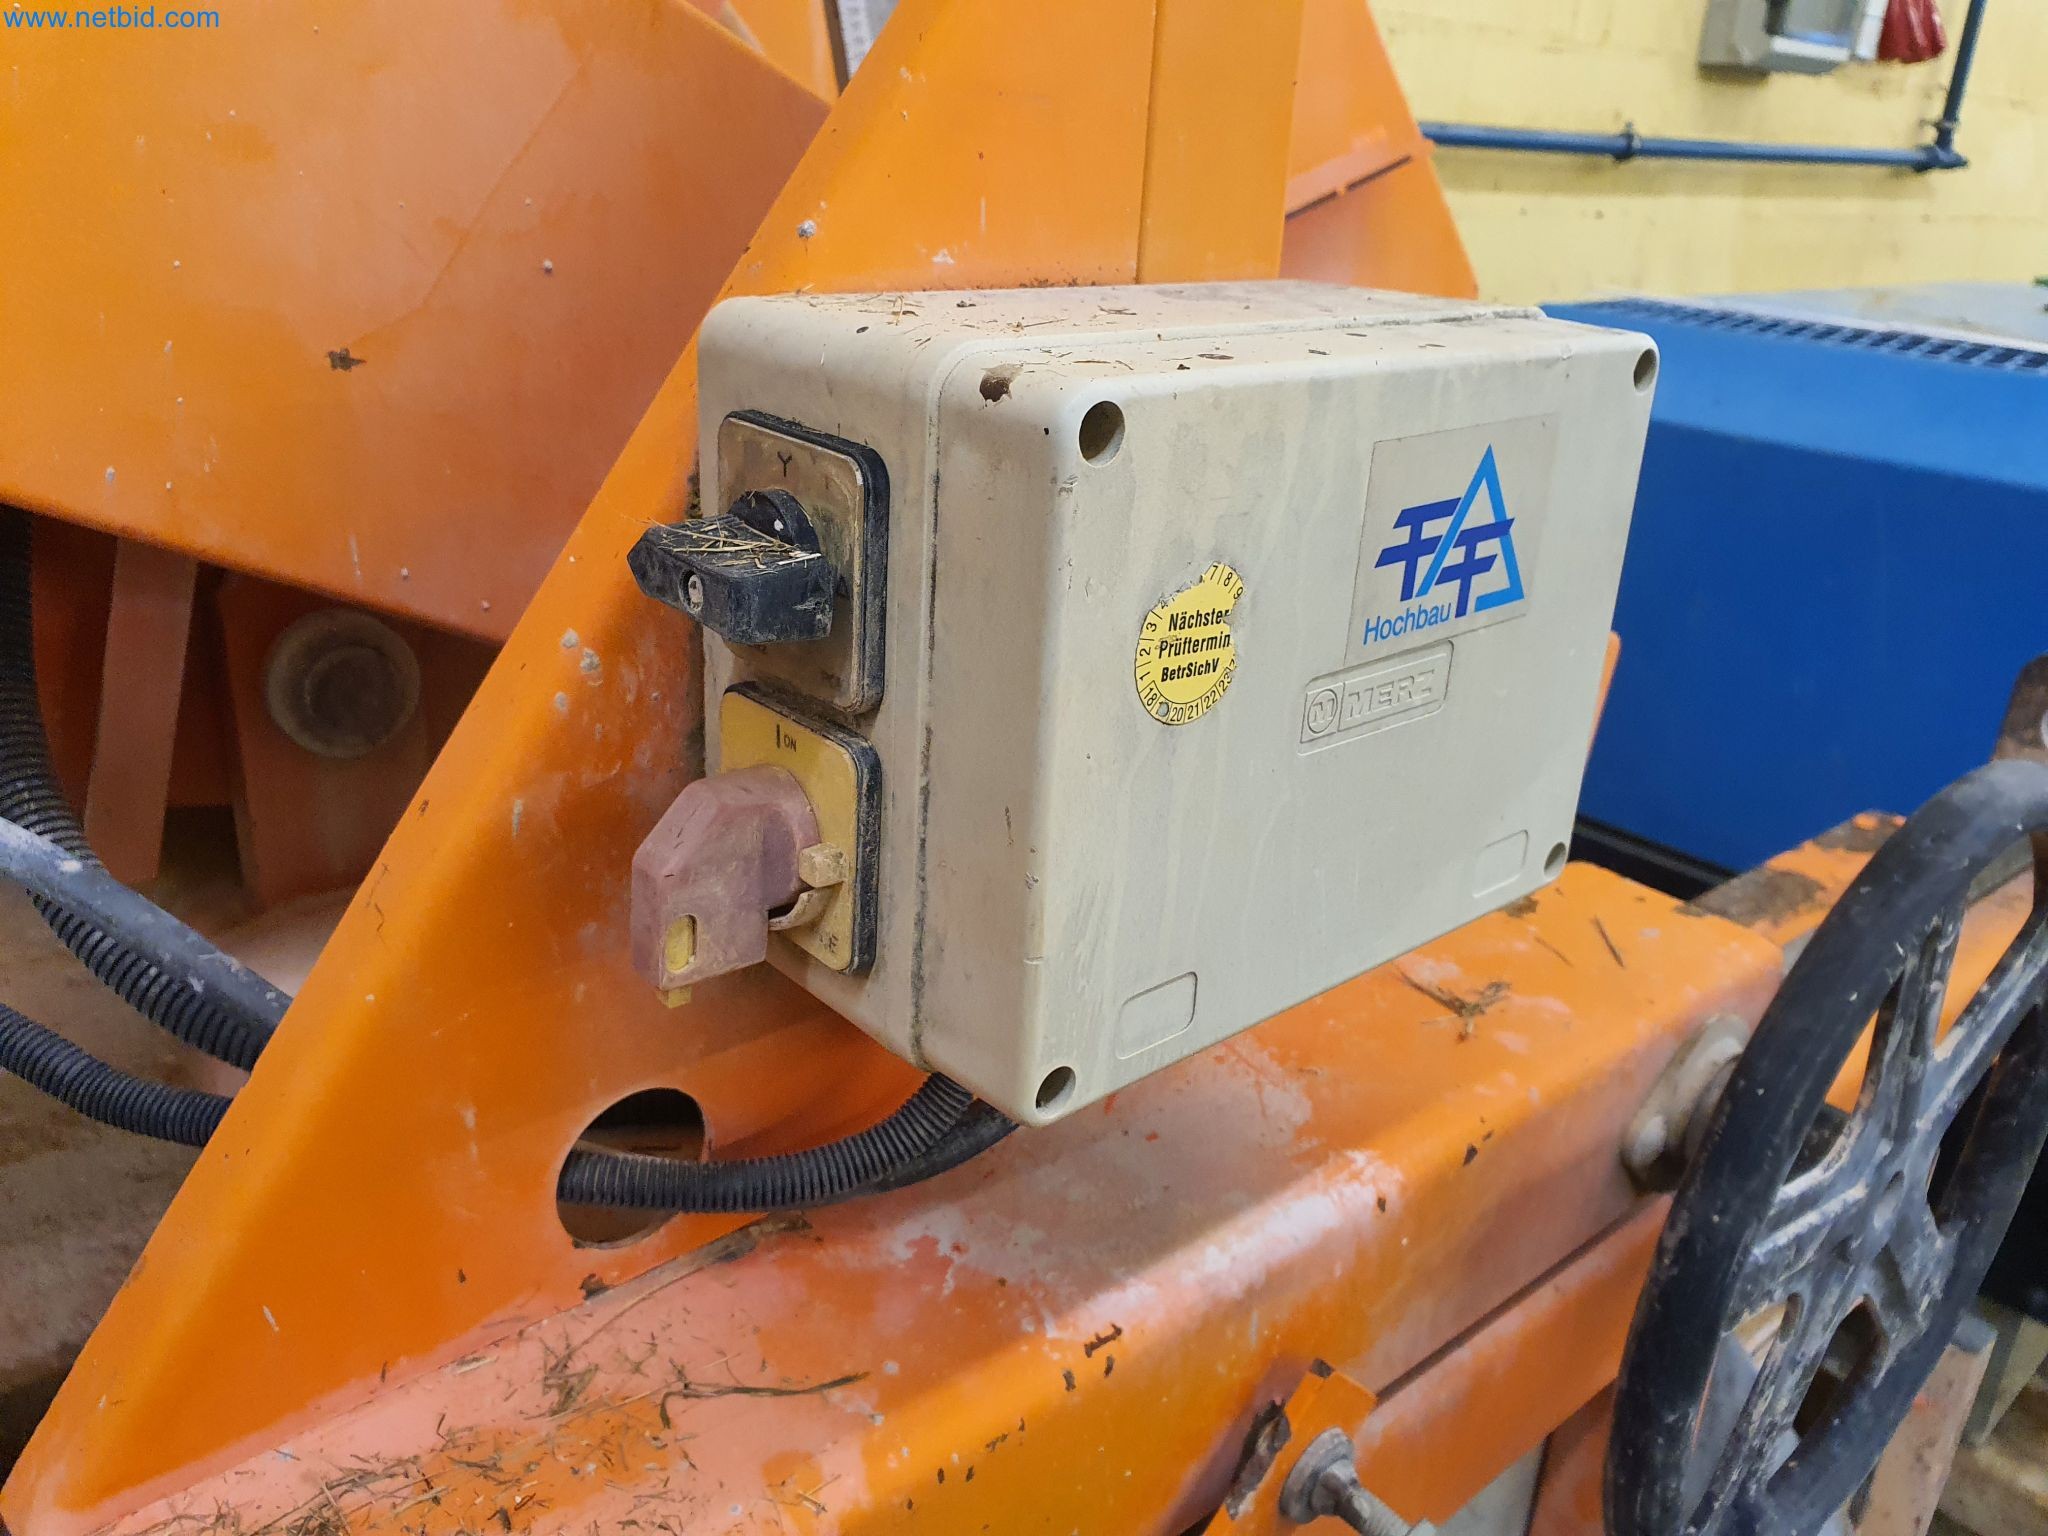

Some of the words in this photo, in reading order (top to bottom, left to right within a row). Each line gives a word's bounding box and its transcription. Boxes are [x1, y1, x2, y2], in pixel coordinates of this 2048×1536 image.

[1363, 602, 1452, 645] Hochbau
[1158, 631, 1231, 659] Prüftermin
[1161, 658, 1220, 682] BetrSichV
[1144, 687, 1158, 706] 18
[1170, 706, 1184, 722] 20
[1187, 702, 1199, 720] 21
[784, 734, 796, 752] ON
